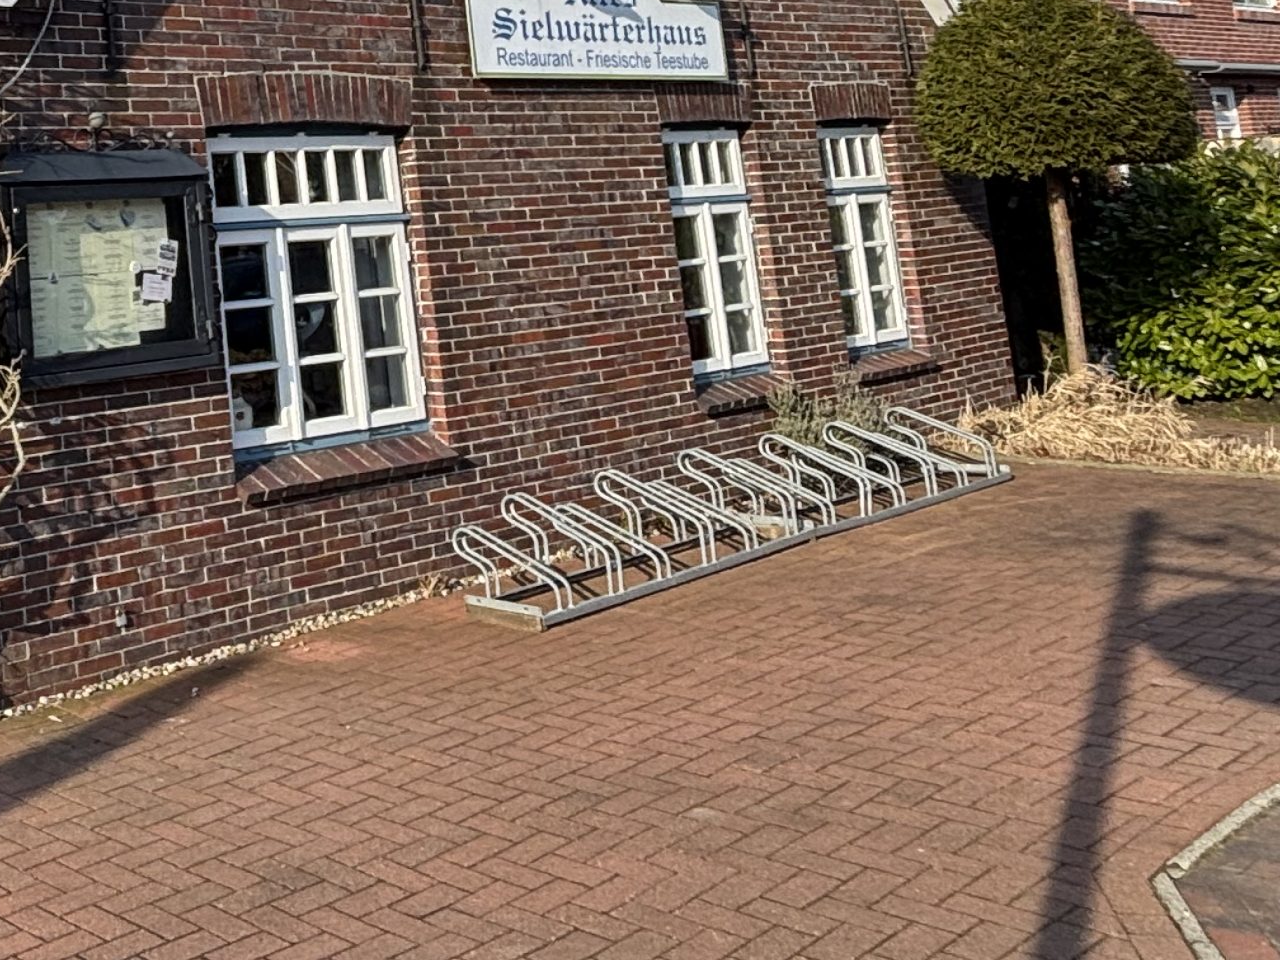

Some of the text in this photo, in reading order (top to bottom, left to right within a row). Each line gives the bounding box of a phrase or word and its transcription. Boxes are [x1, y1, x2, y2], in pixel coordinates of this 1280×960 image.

[492, 7, 707, 52] Sielwärterhaus
[496, 47, 574, 67] Restaurant
[585, 49, 652, 69] Friesische
[654, 51, 709, 70] Teestube
